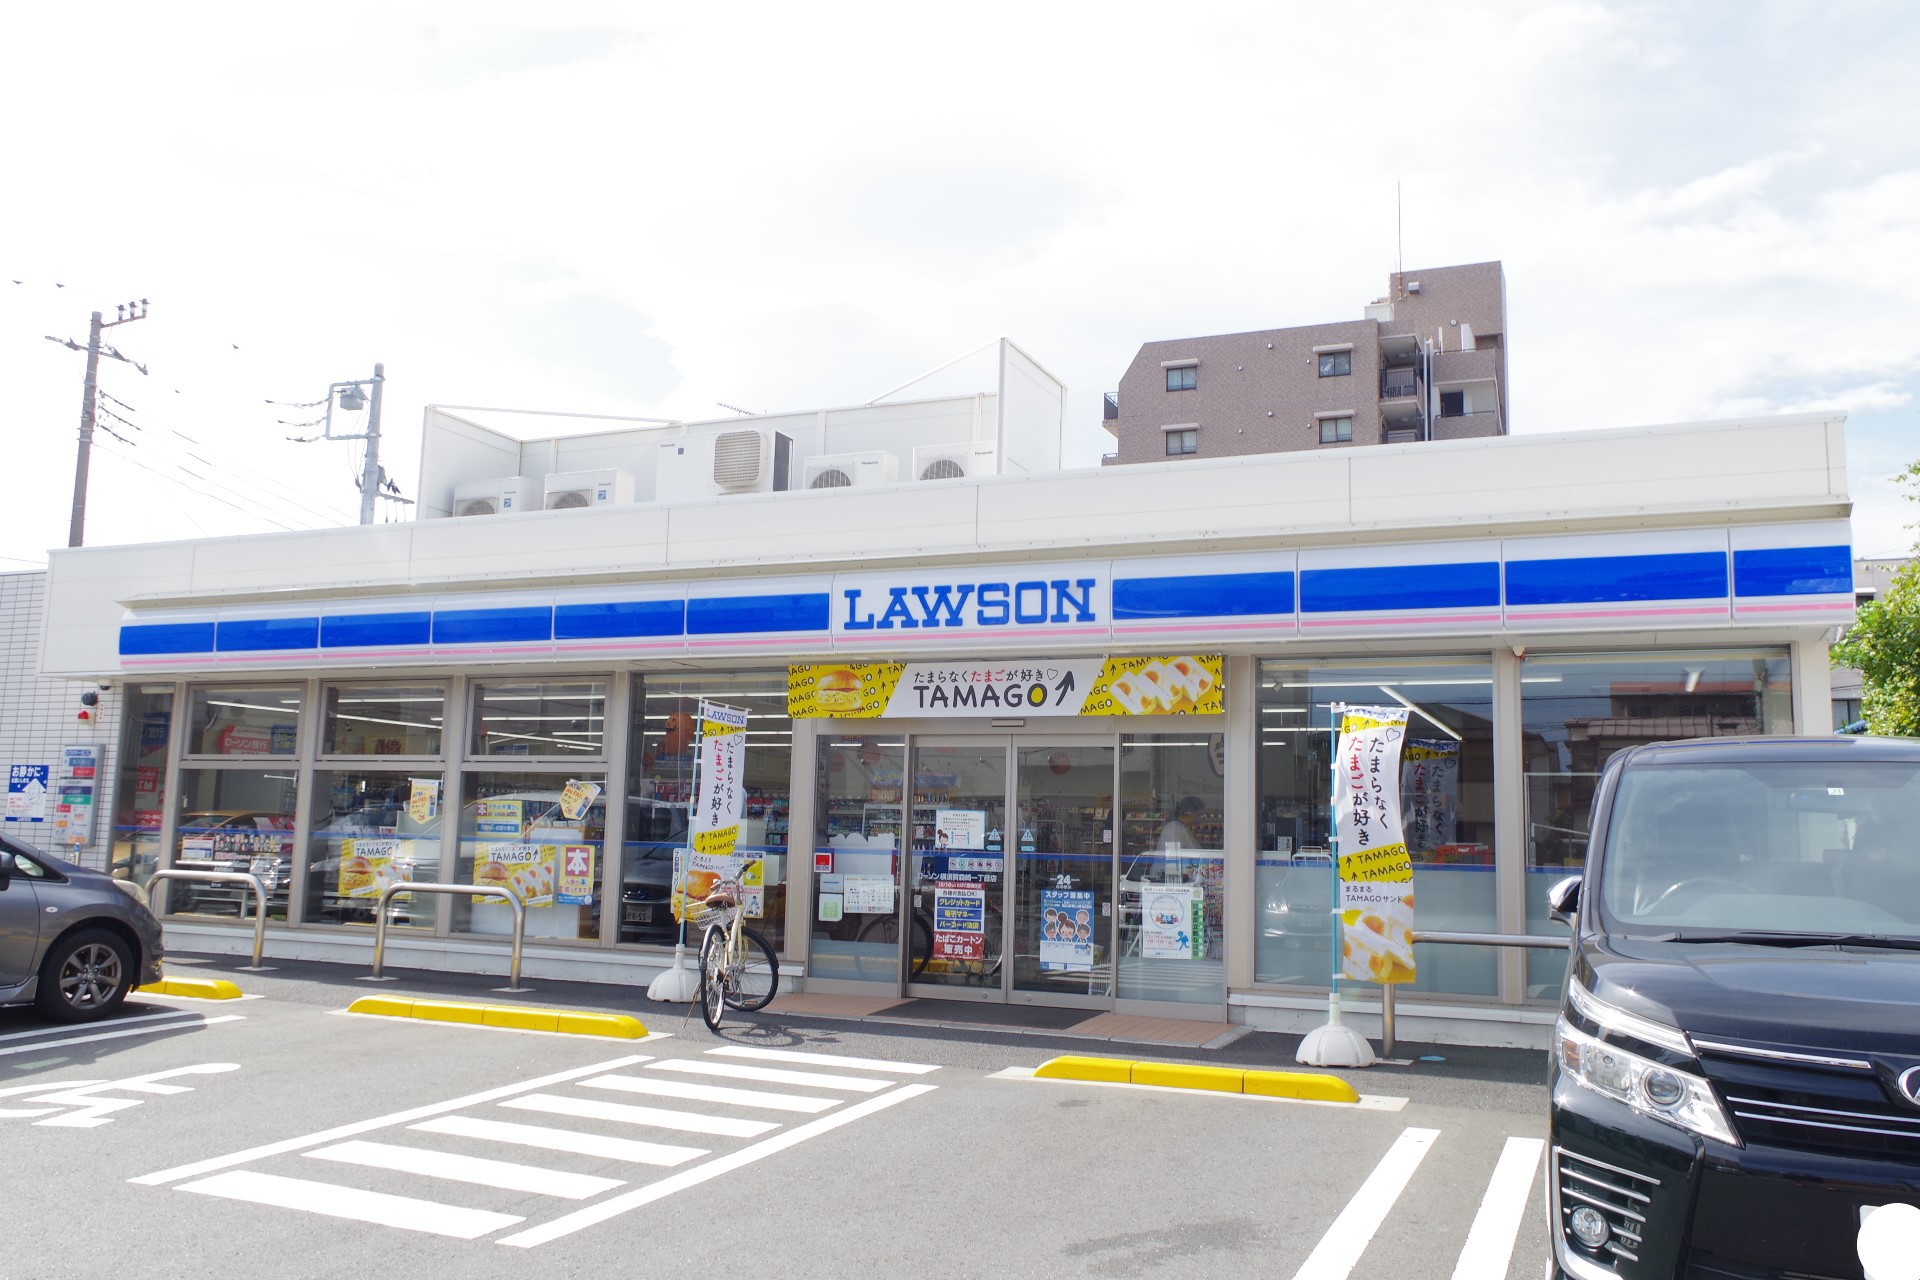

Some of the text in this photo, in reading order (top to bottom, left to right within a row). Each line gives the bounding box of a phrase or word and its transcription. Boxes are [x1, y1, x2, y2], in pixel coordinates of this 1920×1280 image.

[844, 578, 1096, 630] LAWSON
[914, 668, 1044, 684] たまらなくたまごが好き
[913, 683, 1048, 709] TAMAGO
[706, 708, 745, 724] LAWSON
[711, 738, 725, 827] たまごが好き
[726, 741, 735, 815] たまらなく
[1369, 737, 1389, 829] たまらなく
[1348, 736, 1371, 846] たまごが好き
[477, 803, 487, 815] 本
[708, 827, 737, 841] TAMAGO
[356, 847, 393, 857] TAMAGO
[708, 839, 736, 853] TAMAGO
[491, 852, 532, 862] TAMAGO
[567, 848, 588, 875] 本
[1357, 845, 1406, 864] TAMAGO
[1362, 861, 1411, 880] TAMAGO
[1056, 874, 1072, 885] 24
[1045, 891, 1091, 900] スタッフ募集中
[1345, 885, 1373, 893] まるまる
[939, 898, 980, 907] クレジットカード
[1346, 894, 1403, 904] TAMAGOサンド
[945, 910, 974, 918] 電子マネー
[939, 921, 980, 930] バーコード決済
[935, 934, 983, 945] たばこカートン
[944, 944, 973, 955] 販売中
